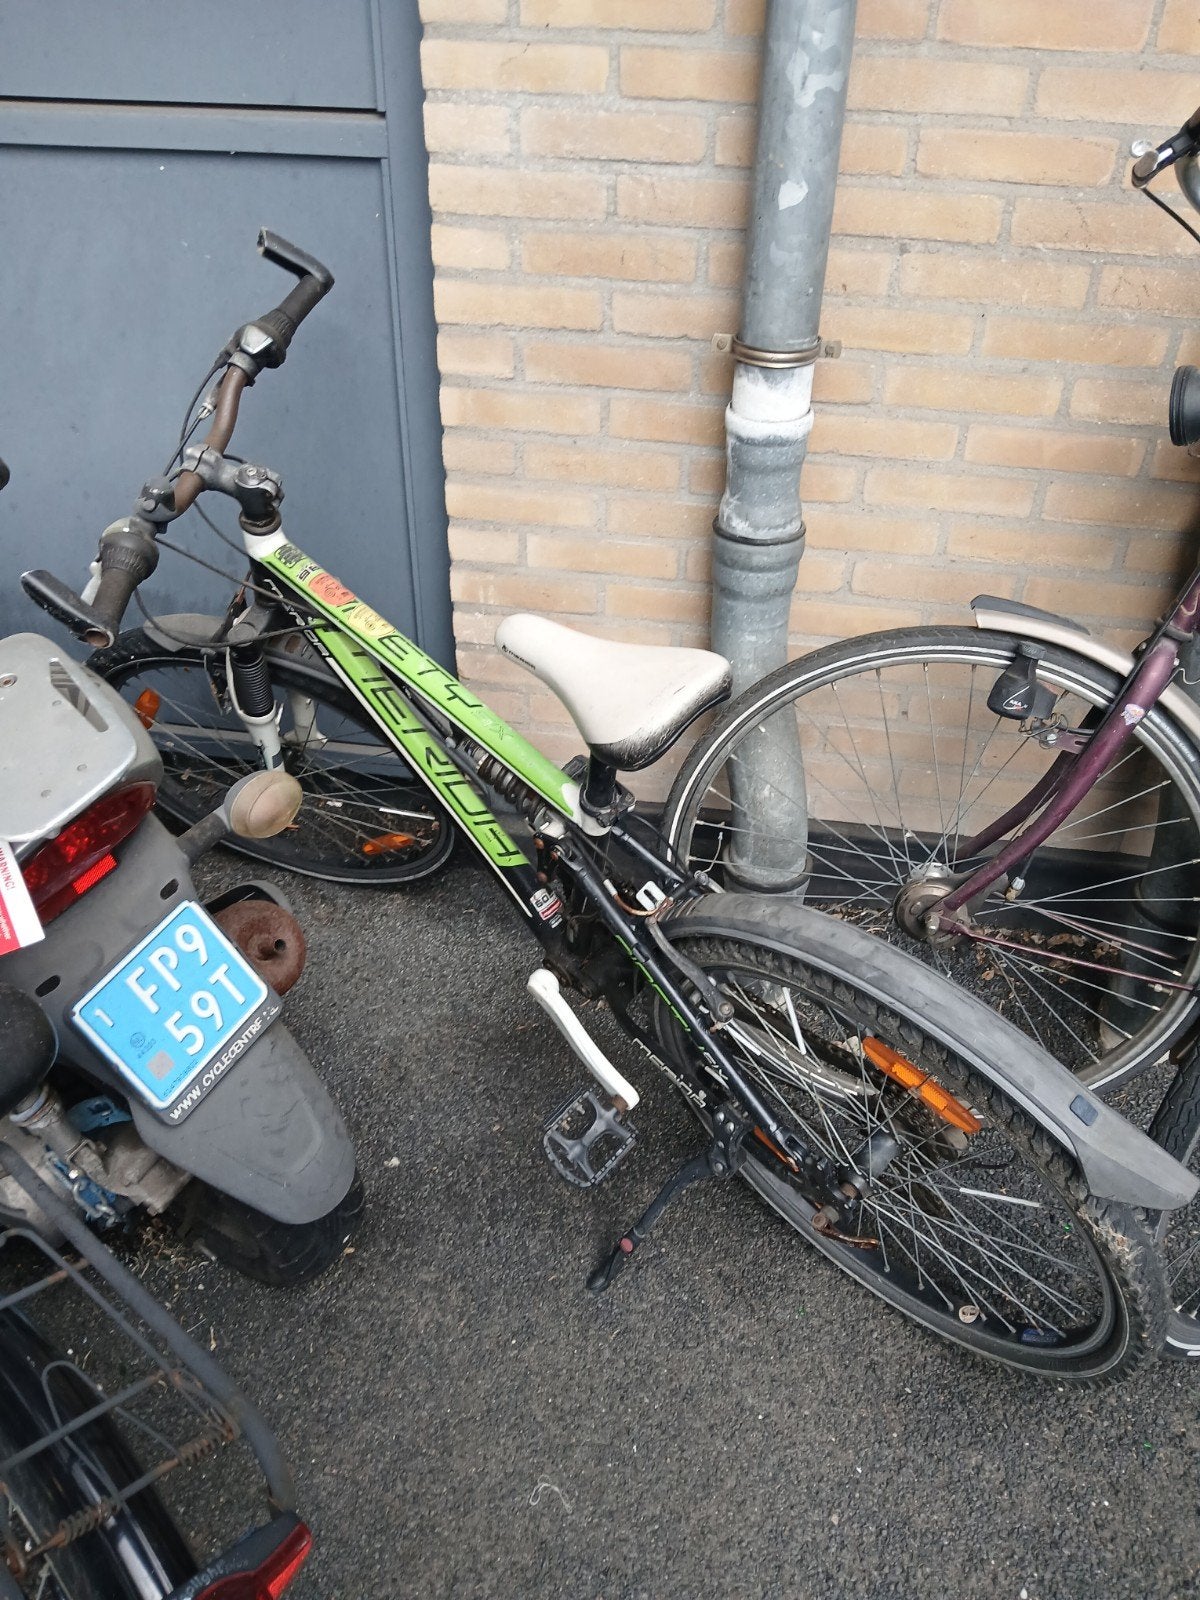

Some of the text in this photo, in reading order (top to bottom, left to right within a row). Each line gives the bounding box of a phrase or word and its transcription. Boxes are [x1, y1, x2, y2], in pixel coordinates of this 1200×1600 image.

[125, 923, 208, 1015] FP9
[164, 963, 246, 1056] 59T
[94, 1008, 114, 1028] 1
